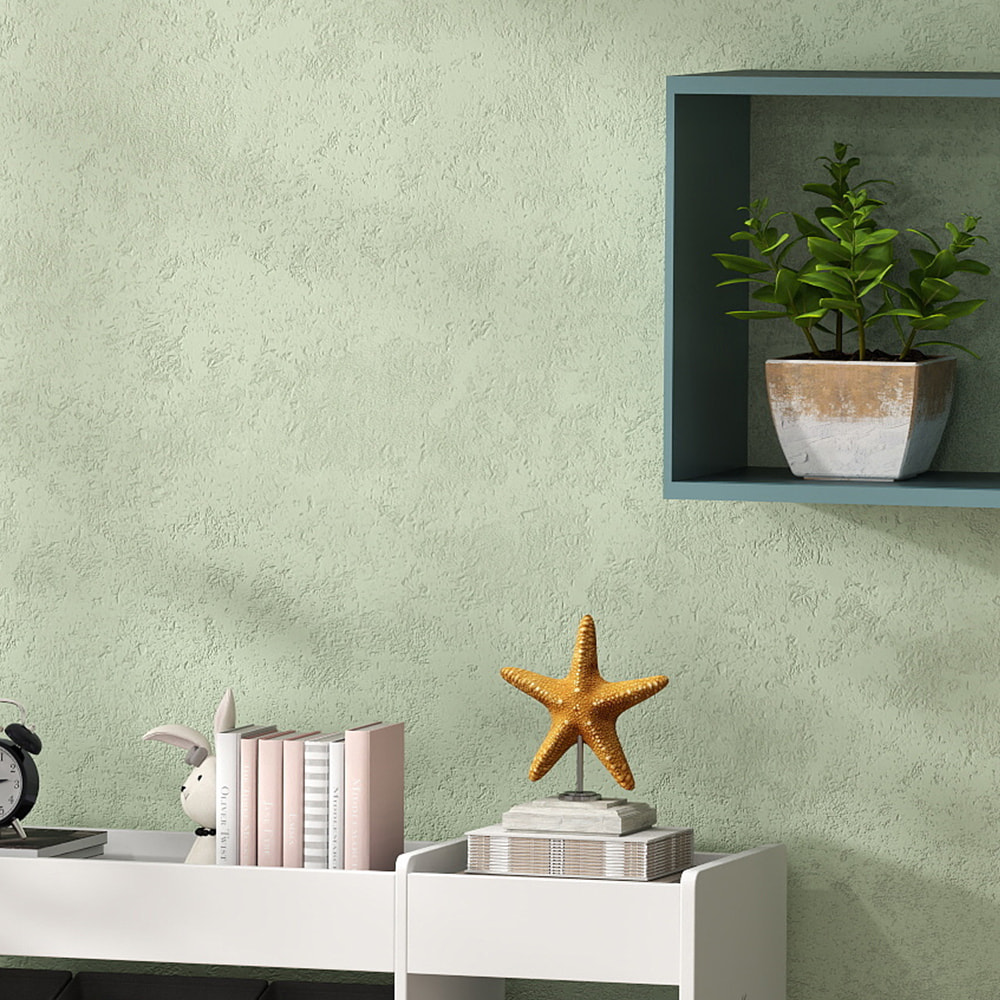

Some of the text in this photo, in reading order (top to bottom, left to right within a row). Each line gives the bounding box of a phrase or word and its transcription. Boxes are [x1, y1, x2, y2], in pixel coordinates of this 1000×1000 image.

[0, 752, 4, 762] 1
[10, 763, 17, 773] 2
[14, 780, 20, 790] 3
[8, 795, 15, 805] 4
[0, 805, 5, 816] 5
[220, 785, 230, 860] OLIVER TWIST
